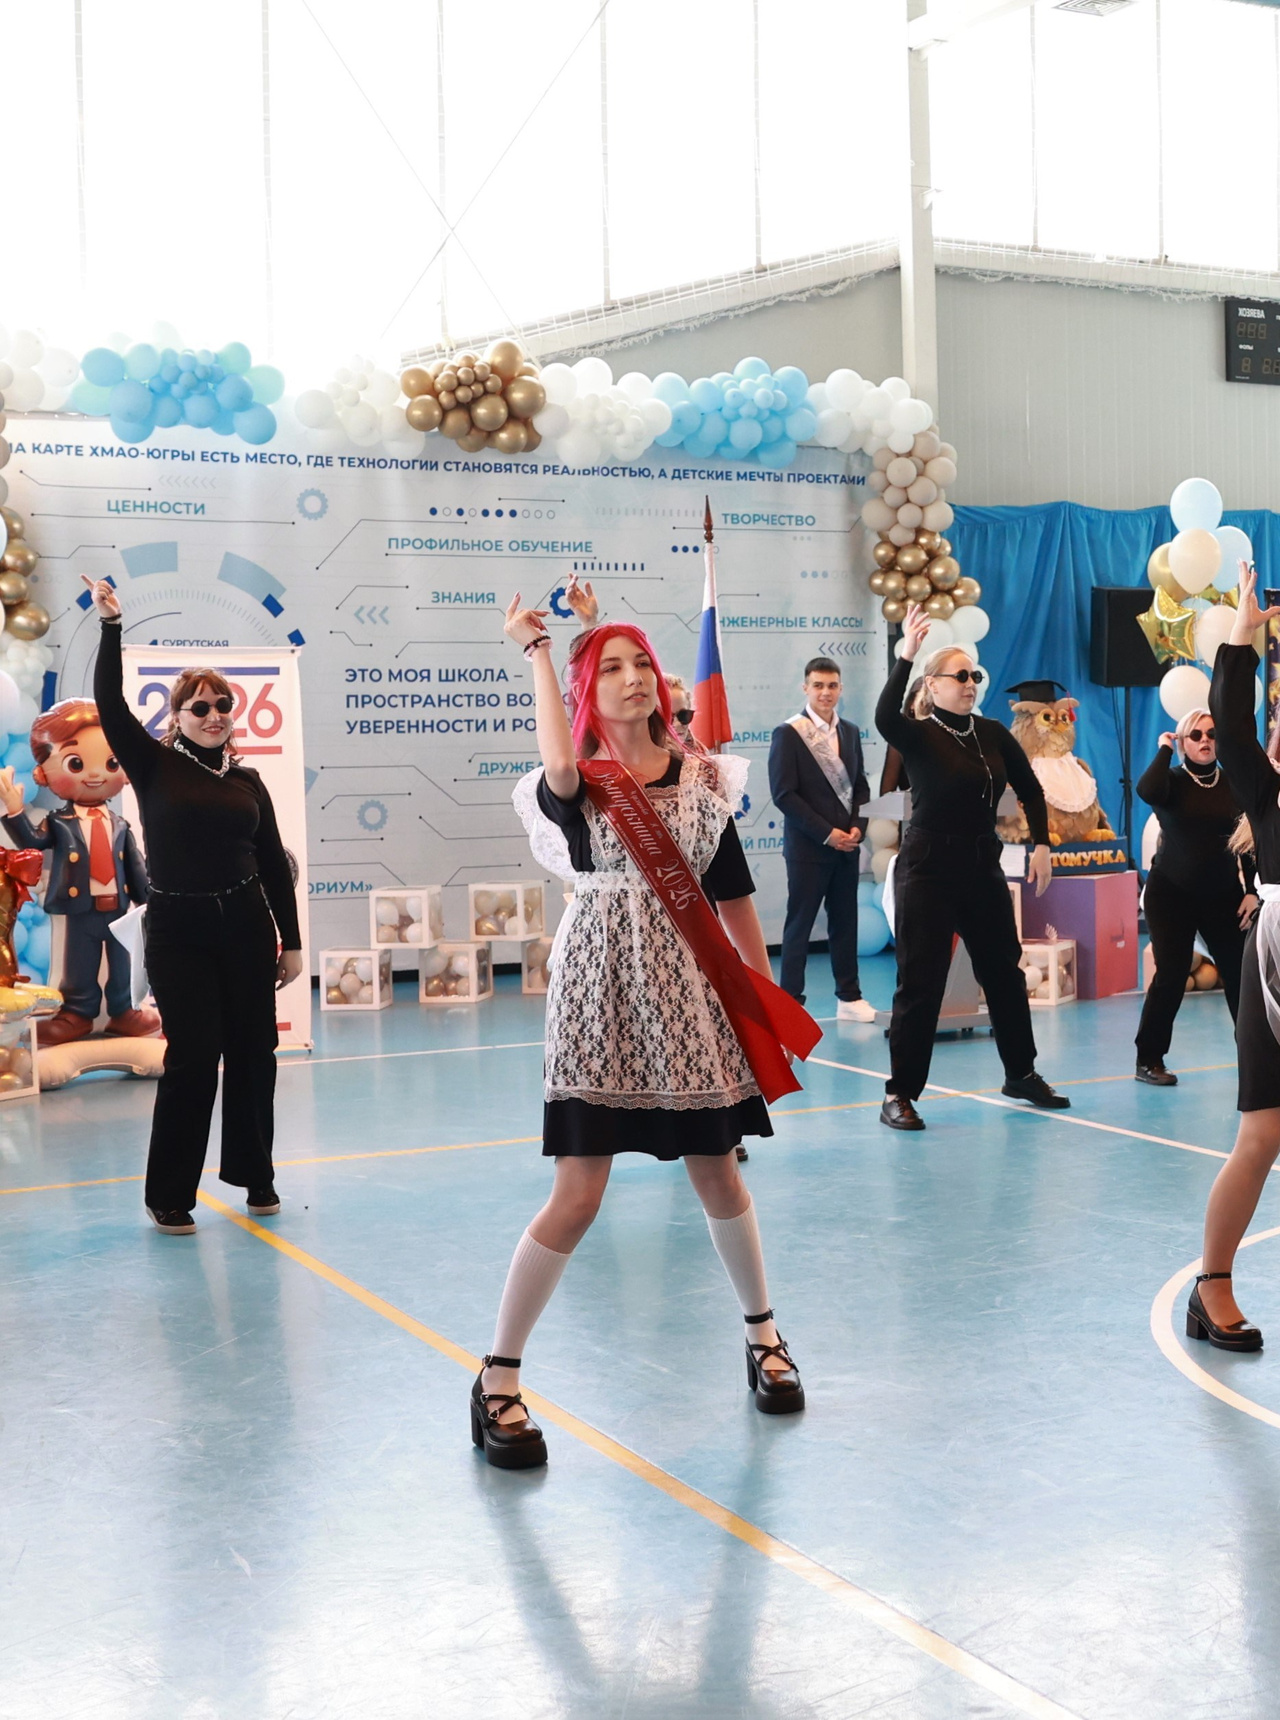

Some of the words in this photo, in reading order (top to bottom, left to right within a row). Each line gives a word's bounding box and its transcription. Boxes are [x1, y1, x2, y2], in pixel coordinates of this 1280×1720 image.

[1238, 307, 1265, 319] ХОЗЯЕВА
[31, 443, 84, 456] КАРТЕ
[89, 445, 196, 462] ХМАО-ЮГРЫ
[200, 450, 241, 464] ЕСТЬ
[244, 452, 302, 468] МЕСТО,
[306, 455, 334, 468] ГДЕ
[338, 456, 439, 471] ТЕХНОЛОГИИ
[443, 460, 539, 475] СТАНОВЯТСЯ
[657, 469, 668, 479] А
[671, 468, 733, 481] ДЕТСКИЕ
[736, 470, 784, 482] МЕЧТЫ
[787, 472, 866, 486] ПРОЕКТАМИ
[106, 499, 206, 515] ЦЕННОСТИ
[722, 512, 816, 527] ТВОРЧЕСТВО
[387, 537, 503, 552] ПРОФИЛЬНОЕ
[508, 540, 593, 554] ОБУЧЕНИЕ
[431, 591, 496, 604] ЗНАНИЯ
[719, 616, 807, 628] НЖЕНЕРНЫЕ
[812, 616, 863, 628] КЛАССЫ
[345, 668, 382, 683] ЭТО
[388, 668, 431, 683] МОЯ
[438, 668, 509, 683] ШКОЛА
[346, 693, 501, 709] ПРОСТРАНСТВО
[138, 683, 283, 739] 226
[346, 718, 487, 735] УВЕРЕННОСТИ
[492, 718, 506, 733] И
[591, 764, 662, 856] Выпускница
[1028, 849, 1127, 868] ТОМУЧКА
[654, 859, 698, 910] 2026
